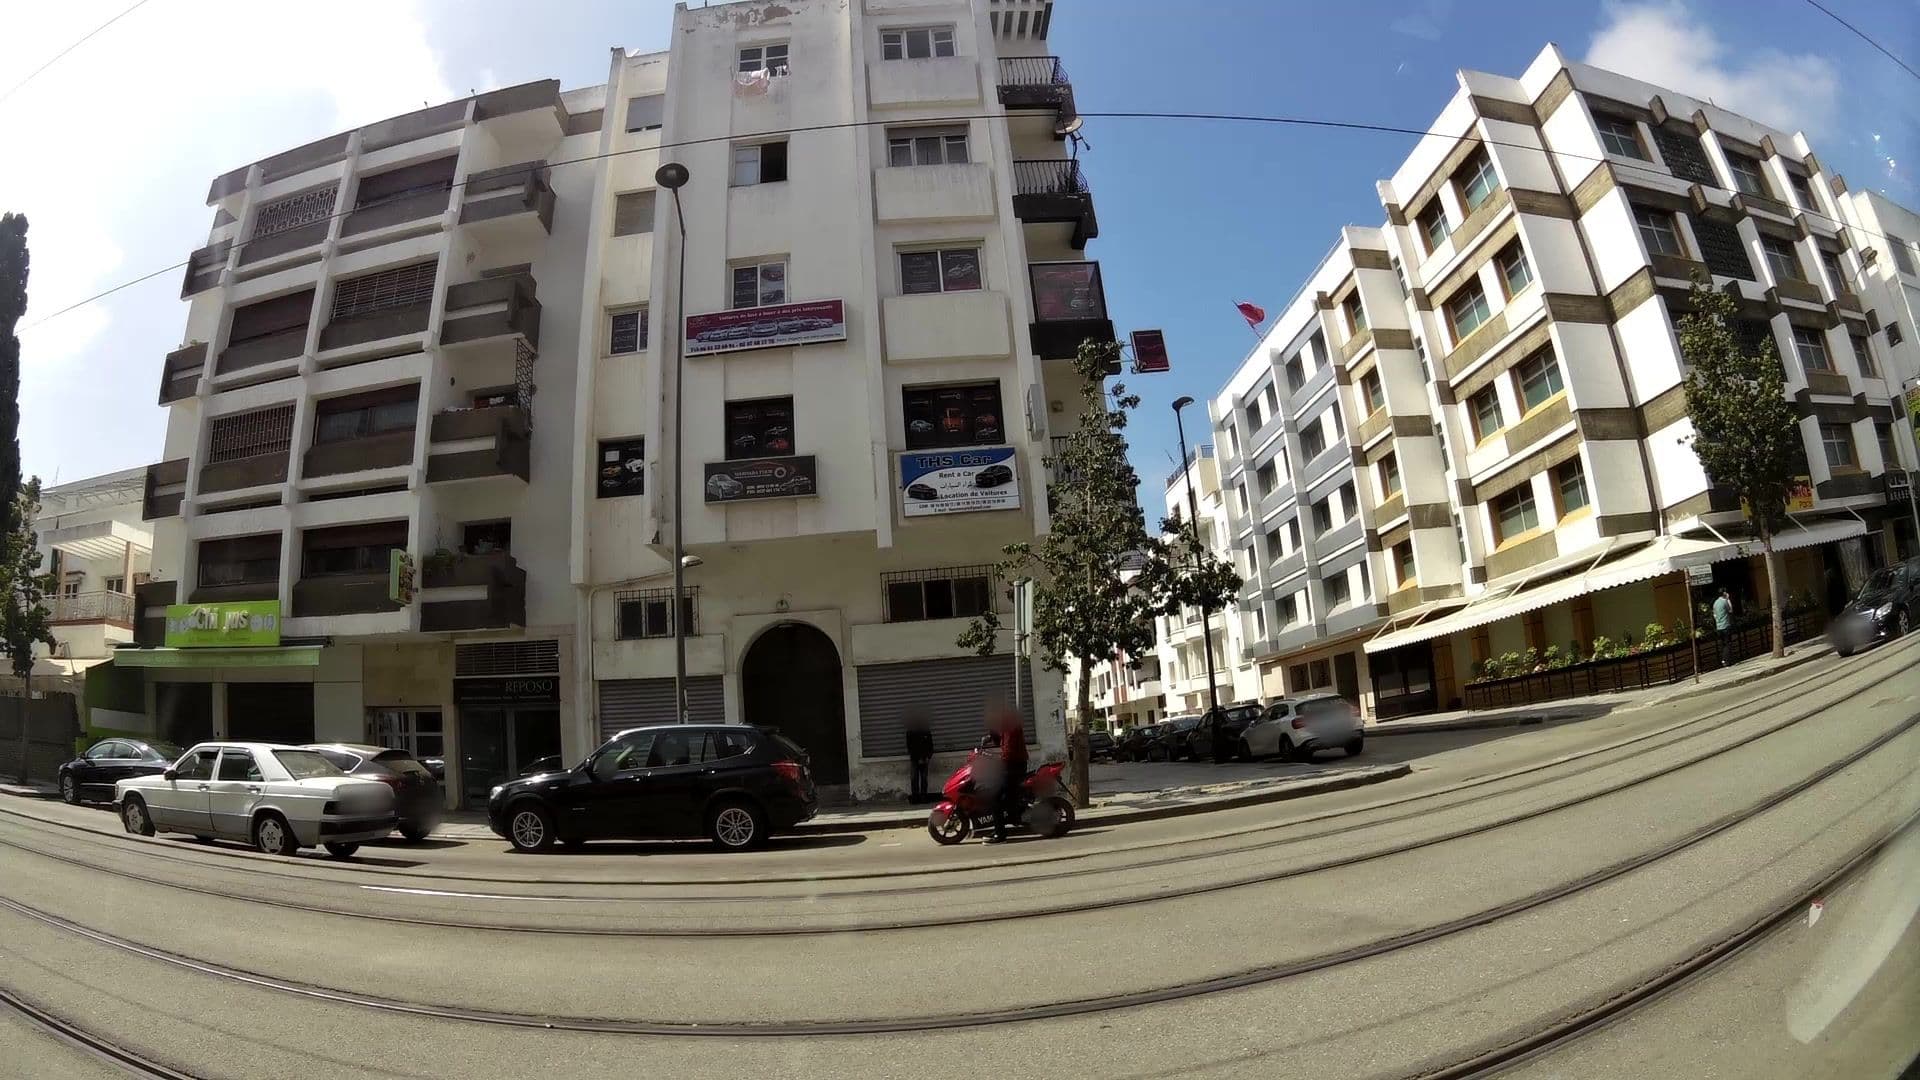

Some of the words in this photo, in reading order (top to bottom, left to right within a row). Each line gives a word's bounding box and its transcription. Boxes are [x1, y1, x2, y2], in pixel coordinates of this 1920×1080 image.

[917, 454, 954, 468] THS
[960, 453, 992, 465] Car
[939, 471, 955, 479] Rent
[940, 491, 968, 500] Location
[505, 680, 553, 693] REPOSO
